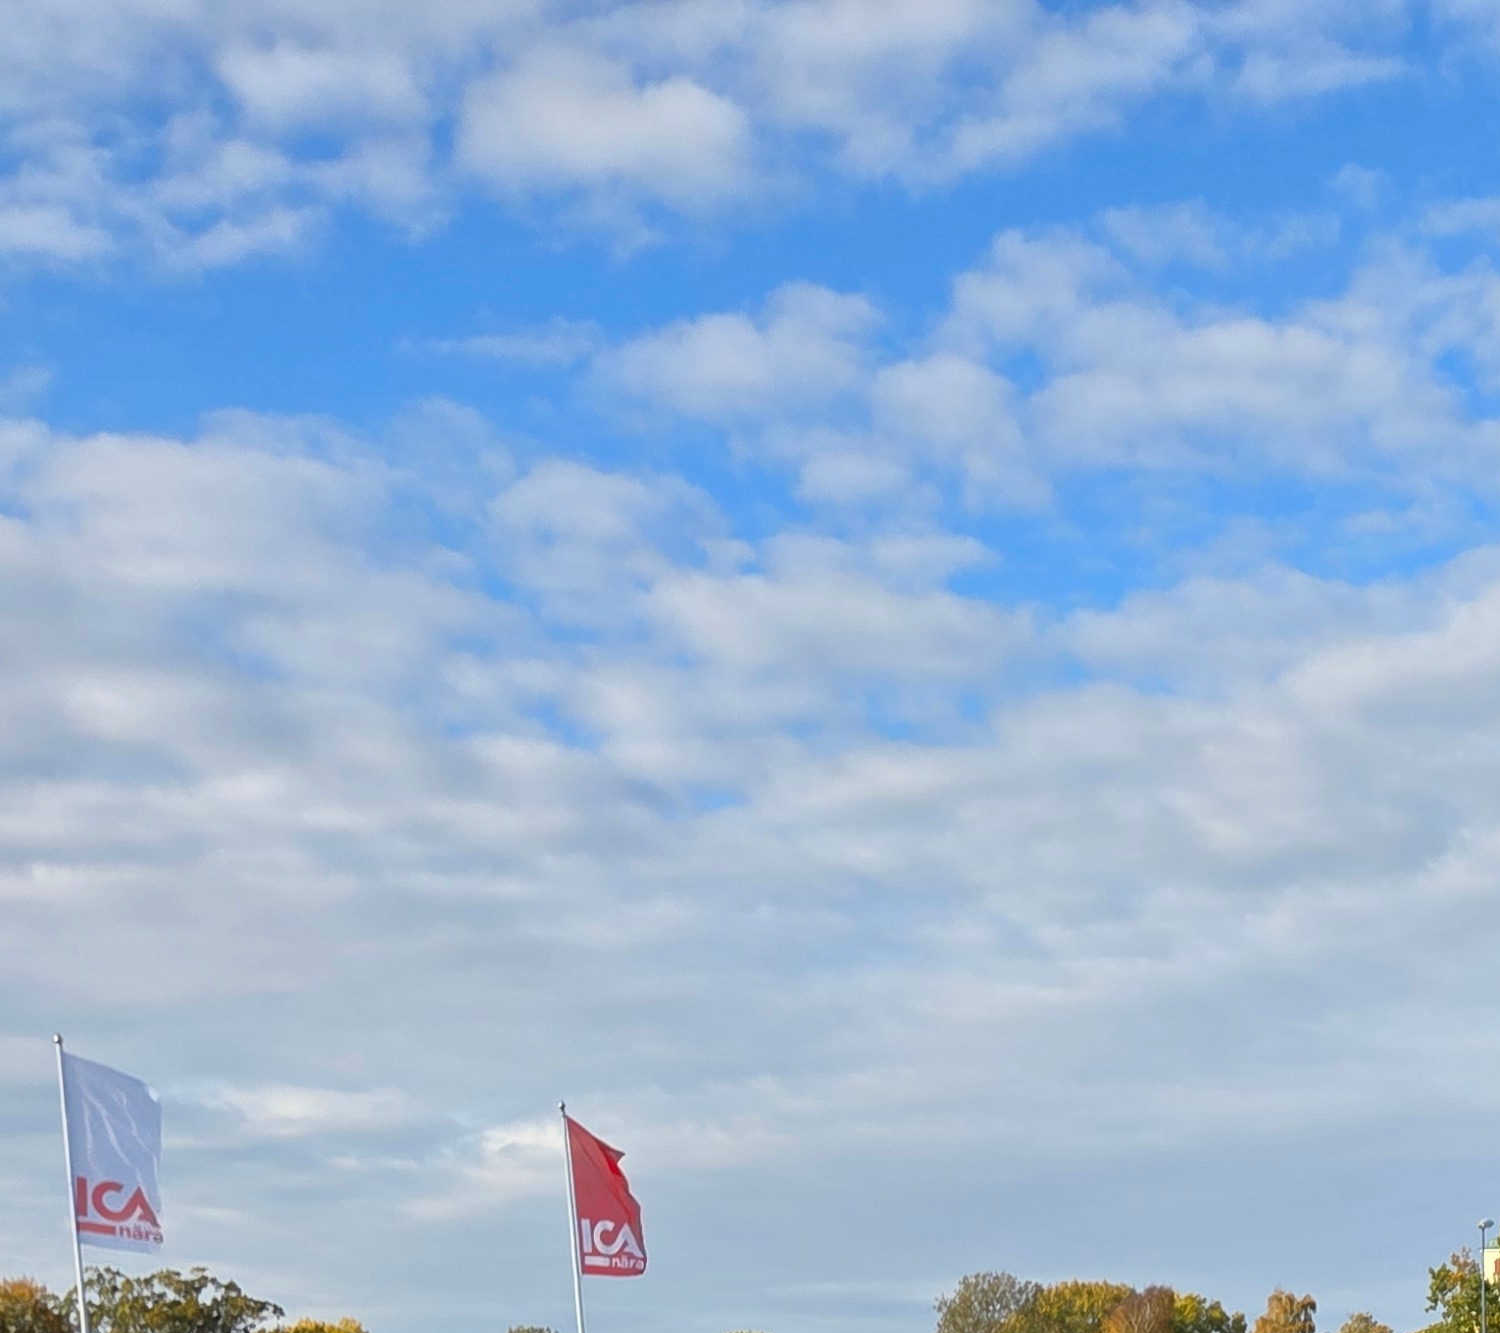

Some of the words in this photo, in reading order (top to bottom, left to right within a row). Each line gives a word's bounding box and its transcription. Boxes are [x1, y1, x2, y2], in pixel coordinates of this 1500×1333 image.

[77, 1176, 160, 1229] ICA
[119, 1224, 164, 1244] nära
[581, 1218, 644, 1258] ICA
[612, 1255, 645, 1270] nära
